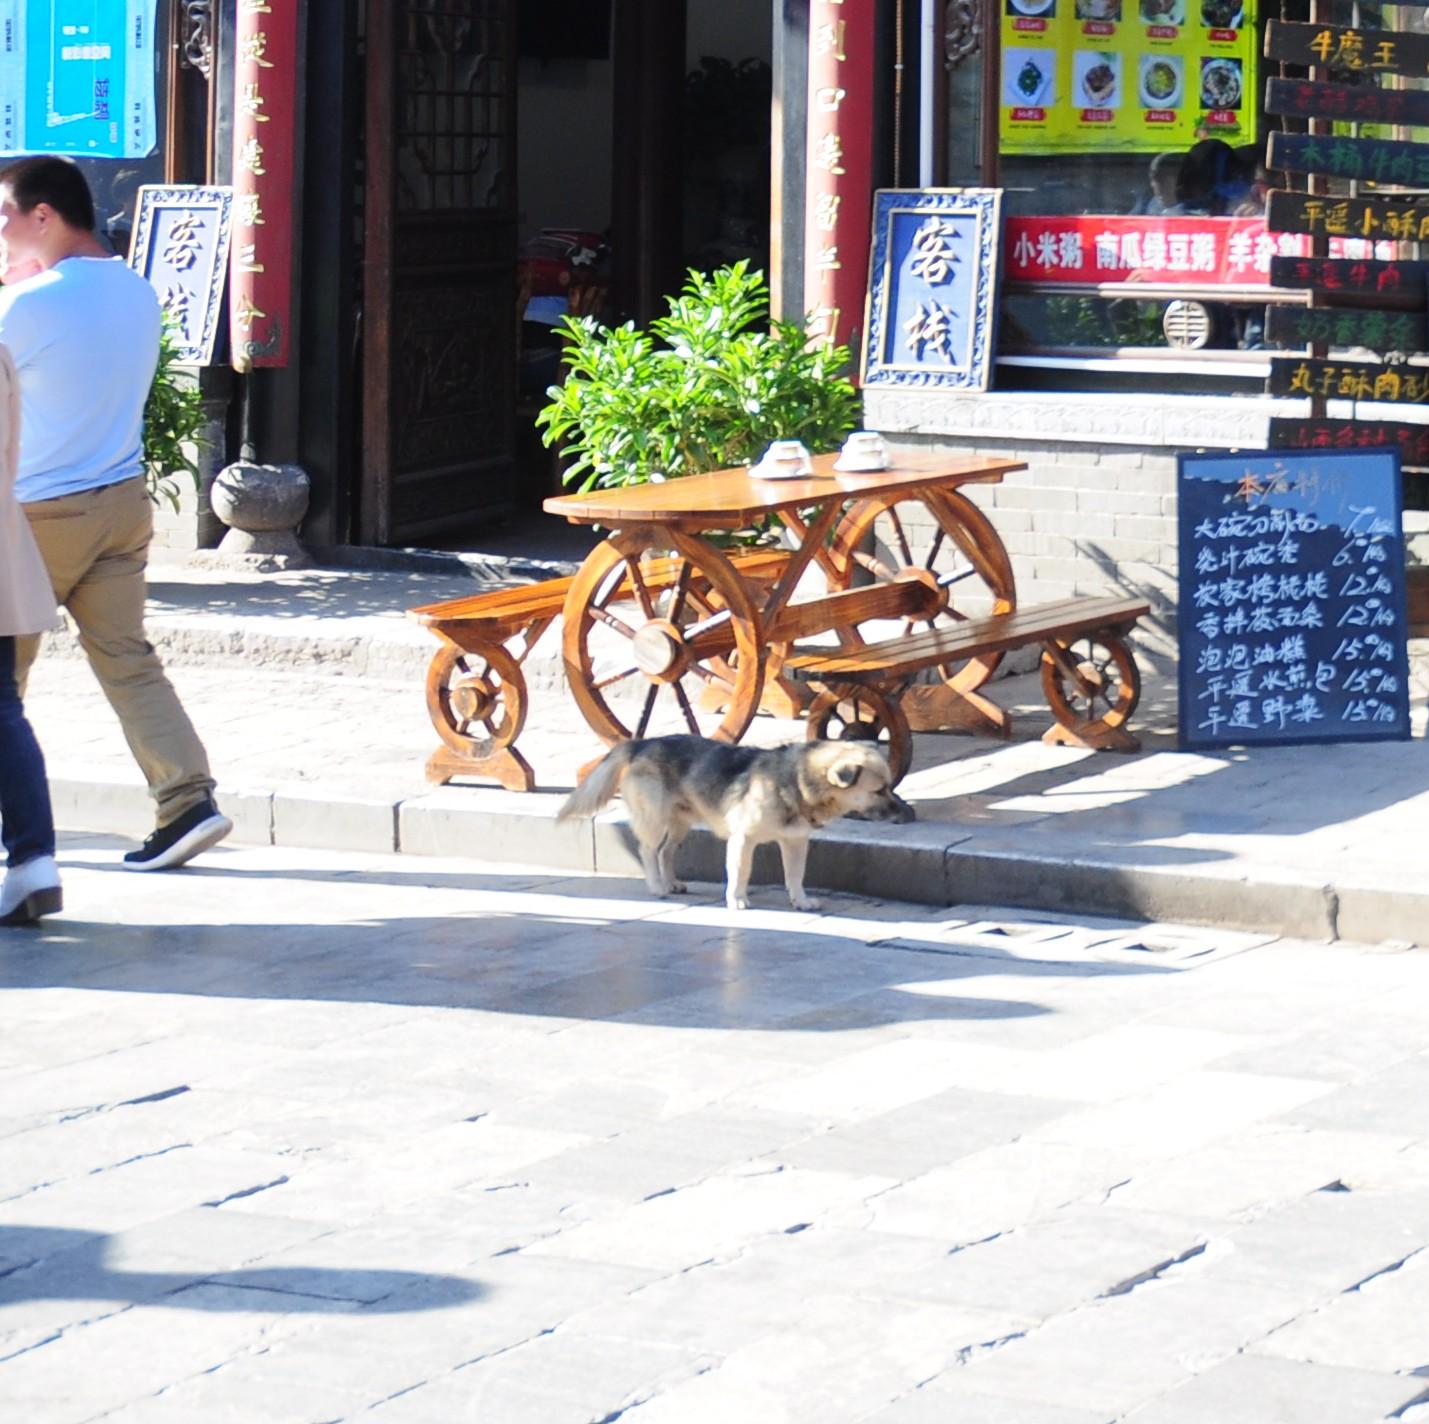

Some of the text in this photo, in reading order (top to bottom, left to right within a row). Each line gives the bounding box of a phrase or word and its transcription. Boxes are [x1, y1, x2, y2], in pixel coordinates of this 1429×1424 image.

[1309, 29, 1399, 70] 牛魔王
[1013, 231, 1083, 269] 小米粥
[1094, 232, 1217, 272] 南瓜绿豆粥
[902, 214, 962, 366] 客栈
